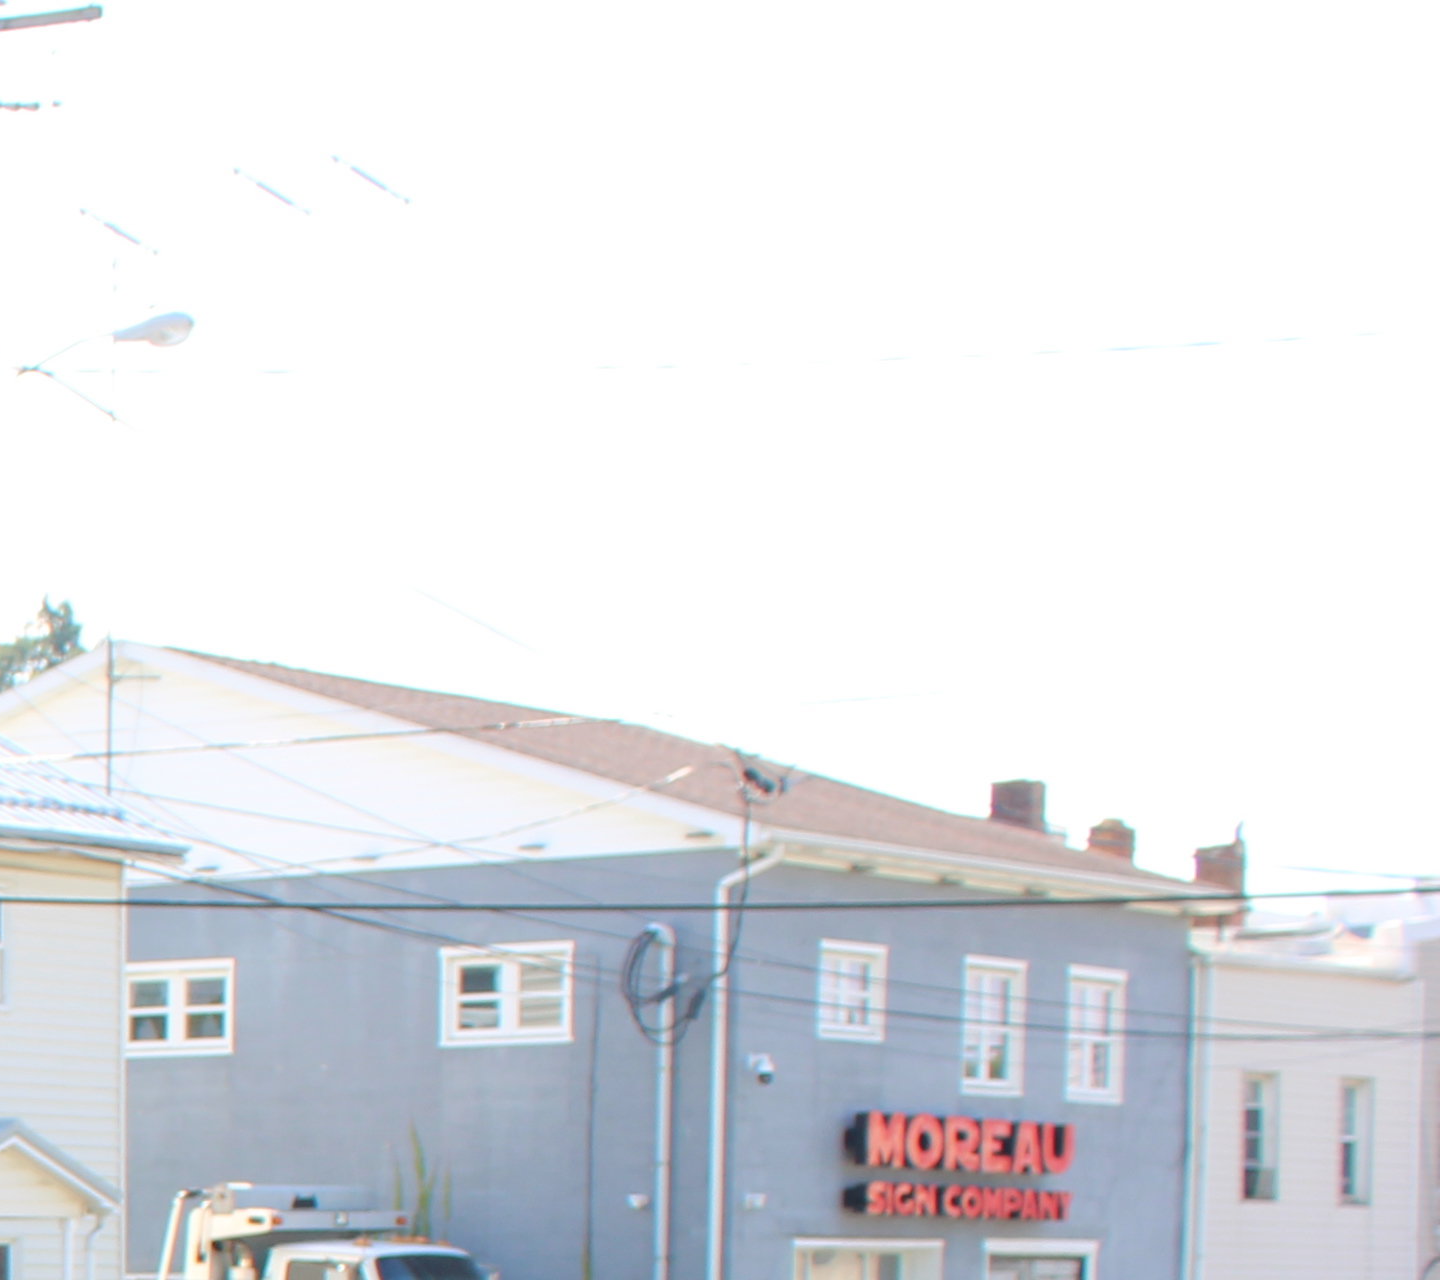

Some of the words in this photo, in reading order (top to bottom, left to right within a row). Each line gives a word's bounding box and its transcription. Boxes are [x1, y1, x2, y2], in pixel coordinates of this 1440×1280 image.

[867, 1110, 1076, 1174] MOREAU
[867, 1181, 937, 1216] SIGN
[943, 1184, 1074, 1221] COMPANY
